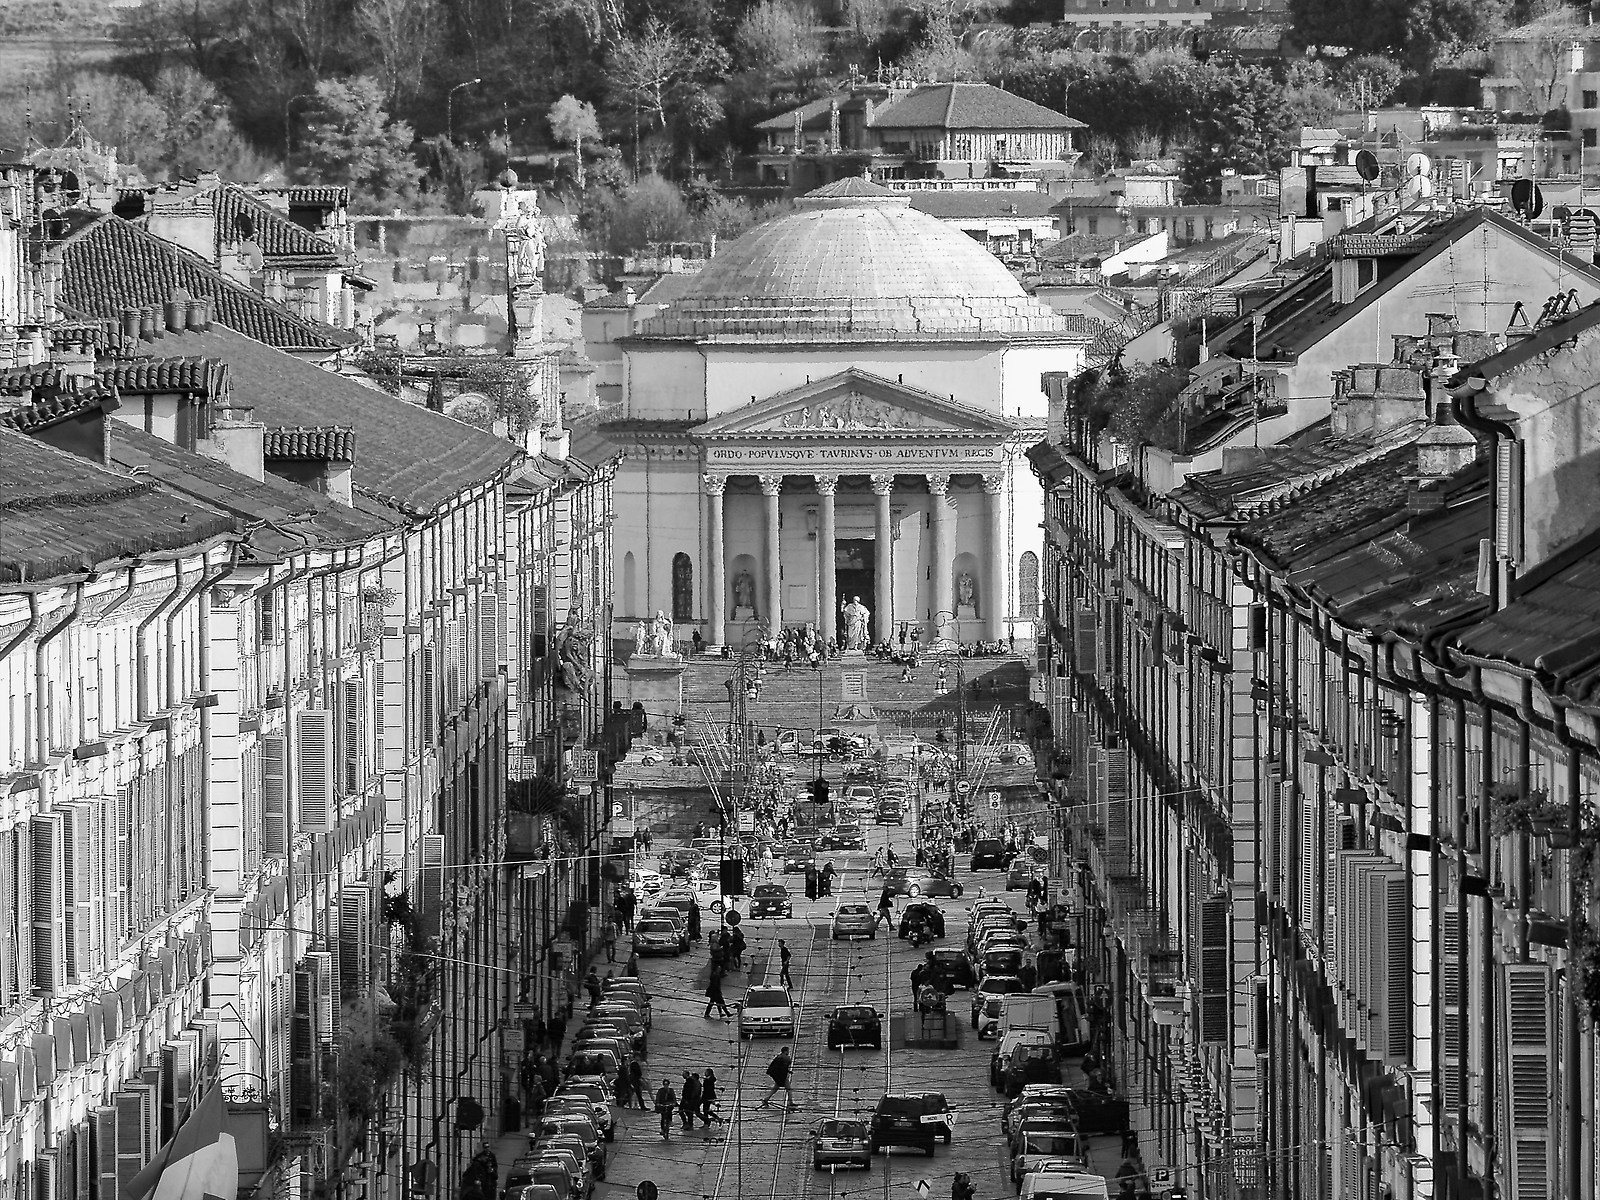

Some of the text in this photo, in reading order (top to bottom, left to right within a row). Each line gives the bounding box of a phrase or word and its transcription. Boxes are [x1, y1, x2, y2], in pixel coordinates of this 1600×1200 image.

[713, 450, 742, 459] ORDO
[820, 449, 873, 459] TAVRINVS
[878, 449, 892, 458] OB
[896, 449, 959, 458] ADVENTVM
[965, 449, 994, 457] REGIS
[613, 804, 623, 817] P
[946, 1114, 955, 1125] R
[1159, 1170, 1167, 1180] P
